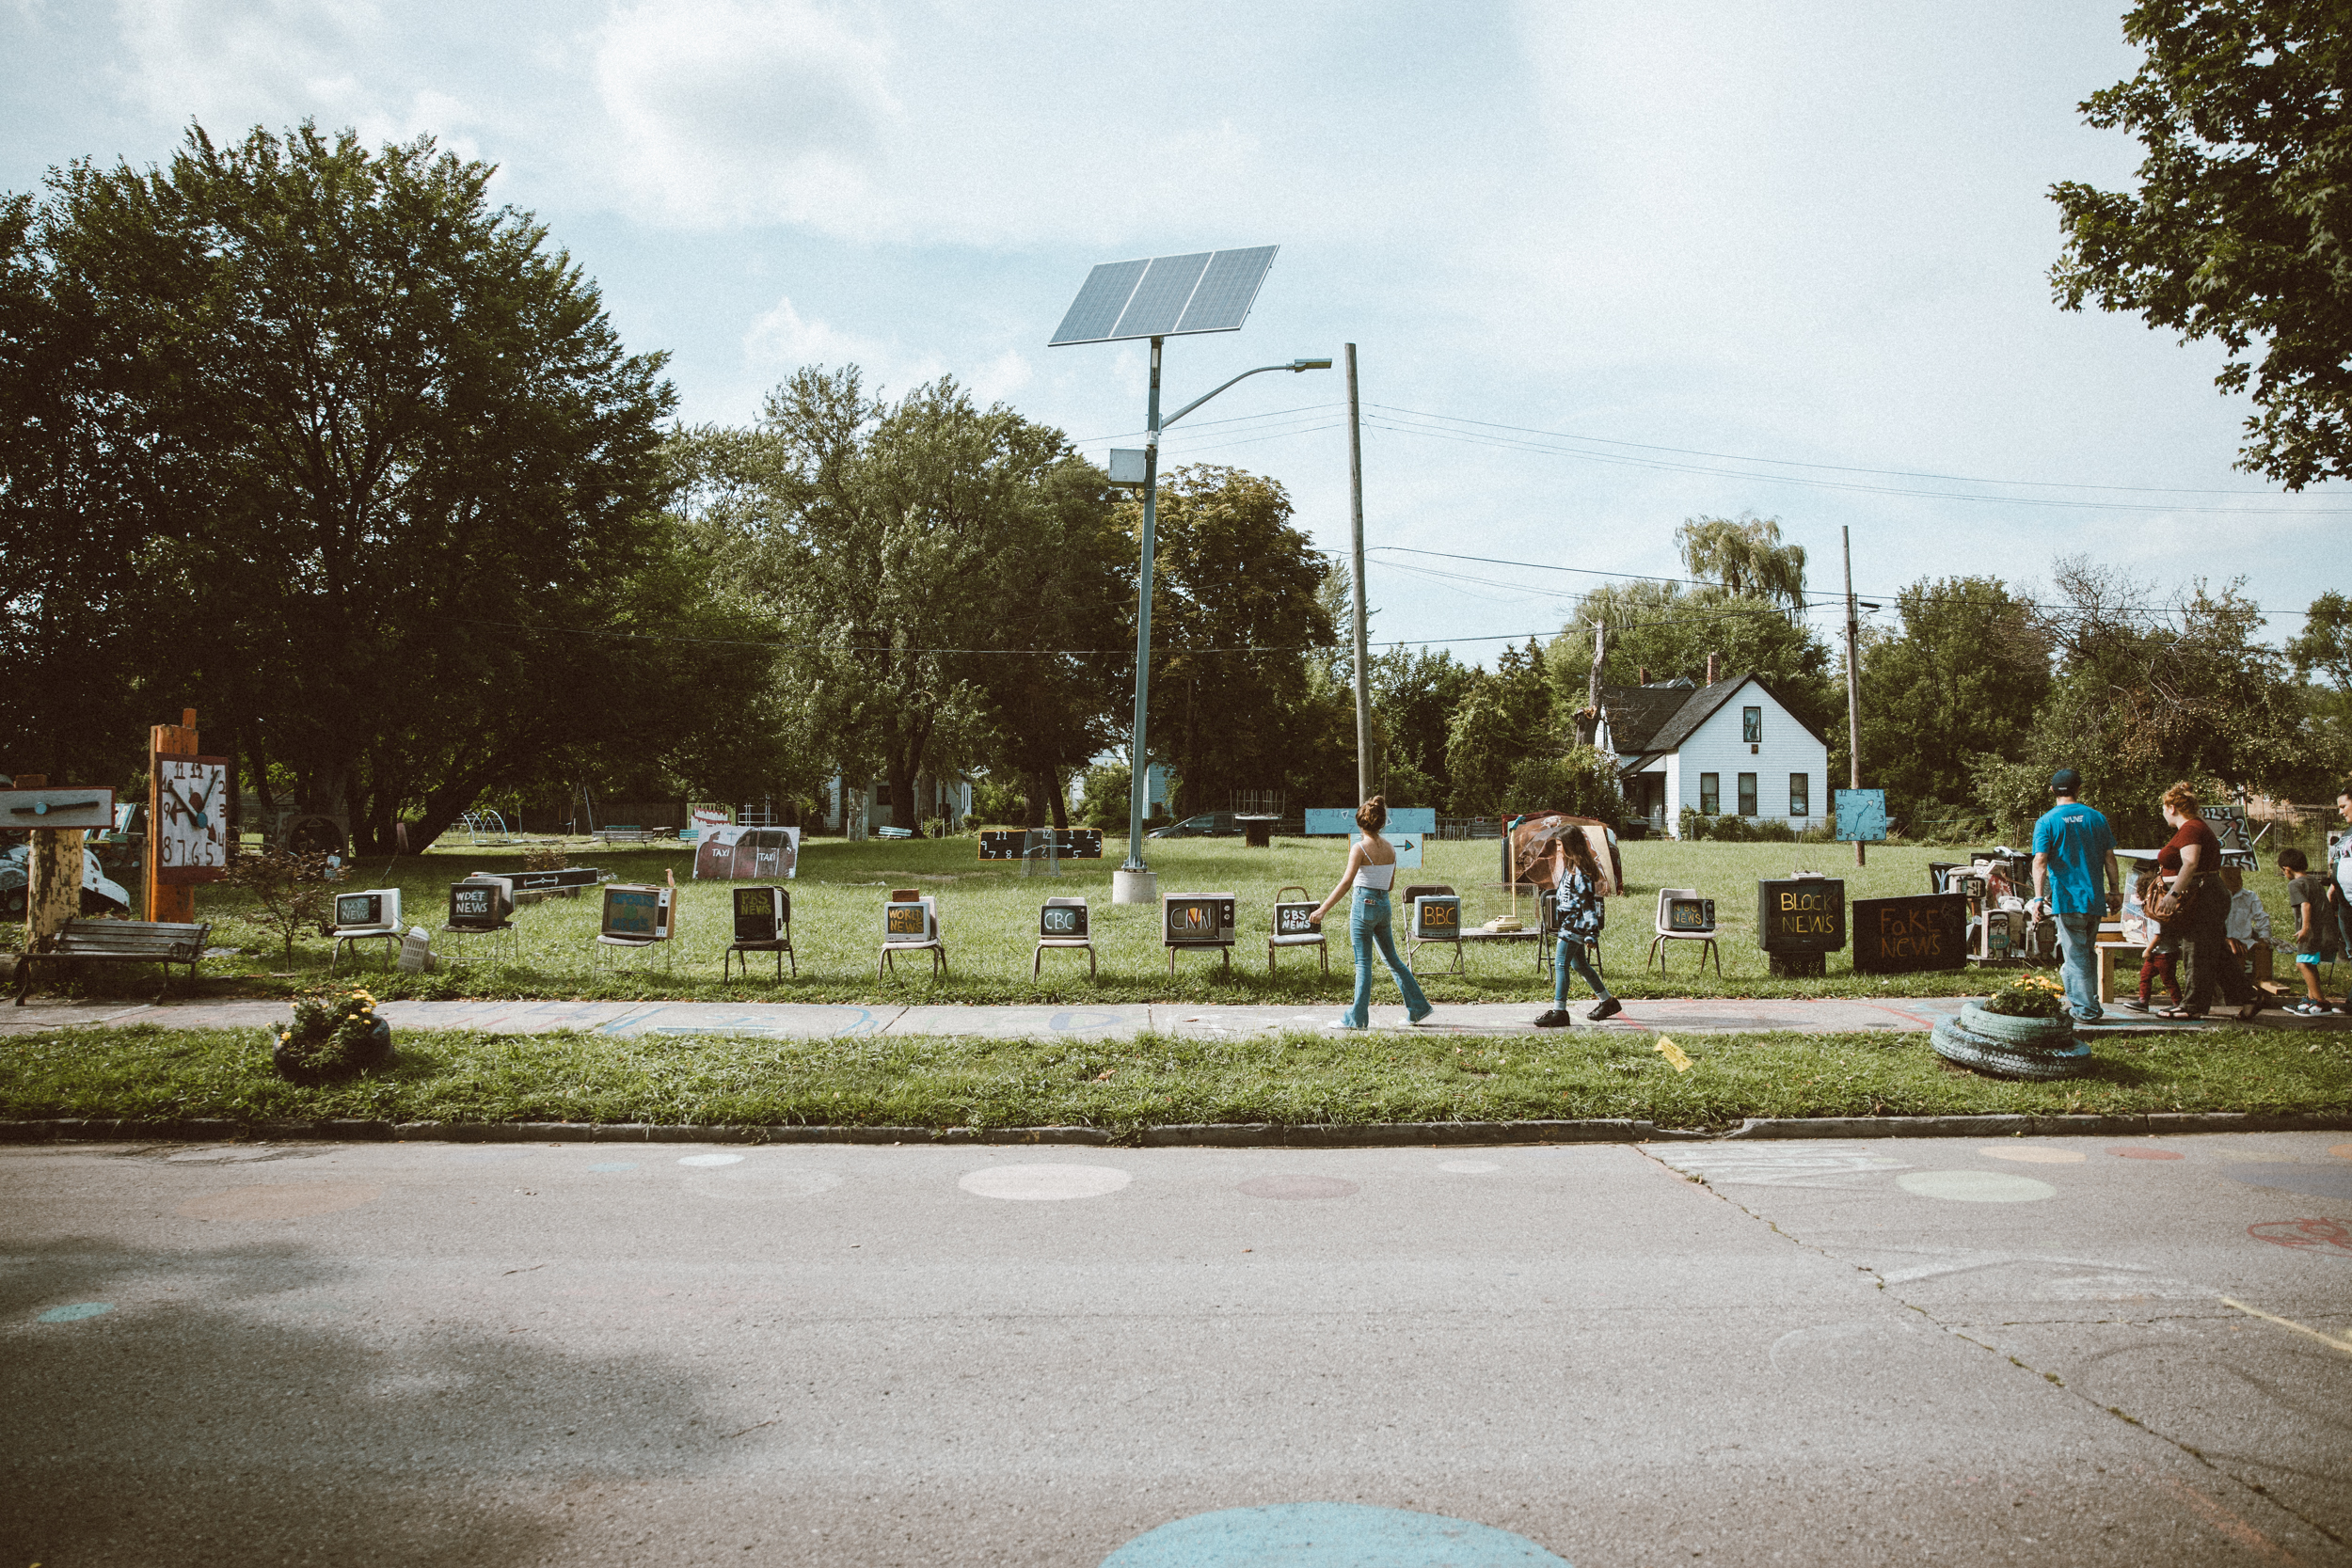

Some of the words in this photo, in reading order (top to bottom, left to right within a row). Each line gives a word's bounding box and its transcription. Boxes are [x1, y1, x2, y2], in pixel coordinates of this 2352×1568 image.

[174, 762, 185, 780] 11
[190, 762, 203, 780] 12
[218, 780, 226, 795] 2
[164, 801, 170, 820] 9
[219, 803, 226, 817] 3
[1877, 800, 1883, 810] 2
[2204, 807, 2222, 819] 12
[1837, 828, 1843, 836] 8
[2236, 818, 2248, 835] 2
[995, 831, 1008, 840] 11
[1069, 830, 1074, 839] 1
[1086, 830, 1094, 839] 2
[217, 832, 225, 855] 4
[980, 840, 988, 850] 9
[1094, 840, 1102, 852] 3
[2239, 837, 2252, 852] 3
[163, 836, 172, 863] 8
[177, 839, 186, 865] 7
[191, 841, 199, 865] 6
[205, 842, 214, 865] 5
[989, 850, 996, 859] 7
[1006, 849, 1012, 859] 8
[1073, 849, 1082, 859] 5
[2241, 855, 2256, 871] 4
[741, 891, 768, 905] PBS
[1781, 893, 1834, 911] BLOCK
[340, 900, 368, 911] WXYZ
[456, 902, 487, 913] NEWS
[740, 905, 771, 915] NEWS
[342, 911, 369, 920] NEWS
[888, 909, 923, 922] WORLD
[1044, 912, 1073, 929] CBC
[1170, 907, 1212, 929] CNN
[1282, 909, 1307, 921] CBS
[1673, 912, 1703, 925] NEWS
[890, 920, 924, 933] NEWS
[1281, 919, 1311, 929] NEWS
